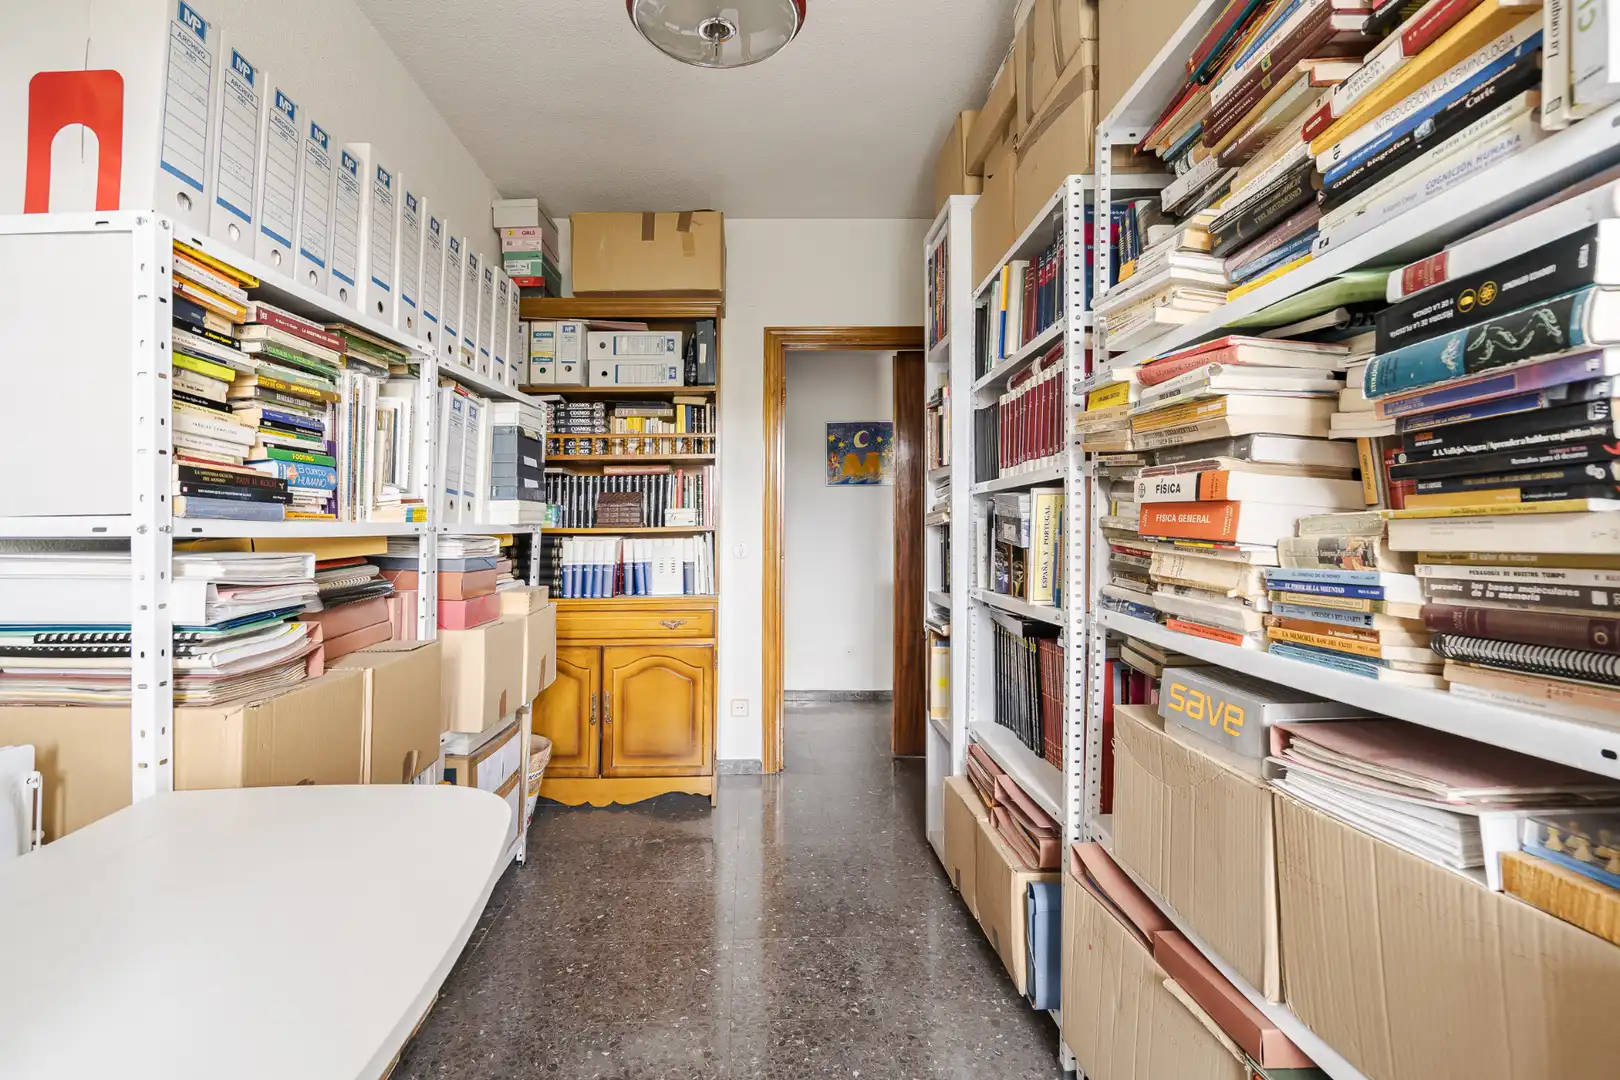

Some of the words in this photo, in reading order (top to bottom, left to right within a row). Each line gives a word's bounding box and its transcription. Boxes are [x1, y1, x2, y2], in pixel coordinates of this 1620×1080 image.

[183, 7, 202, 32] MP
[177, 31, 206, 60] ARCHIVO
[236, 56, 251, 80] MP
[230, 78, 254, 102] ARCHIVO
[1465, 85, 1496, 109] Curie
[279, 95, 293, 115] MP
[314, 127, 326, 146] MP
[1476, 134, 1522, 164] HUMANA
[344, 157, 355, 172] MP
[379, 169, 389, 184] MP
[1332, 167, 1365, 189] Grandes
[1525, 434, 1549, 444] hablar
[298, 477, 326, 487] HUMANO
[1178, 514, 1211, 524] GENERAL
[1320, 585, 1345, 594] VOLUNTAD
[1471, 589, 1482, 597] de
[1498, 592, 1540, 601] memoria
[1487, 582, 1514, 592] bases
[1518, 586, 1580, 597] moleculares
[1289, 631, 1314, 643] MEMORIA
[1167, 682, 1245, 736] save
